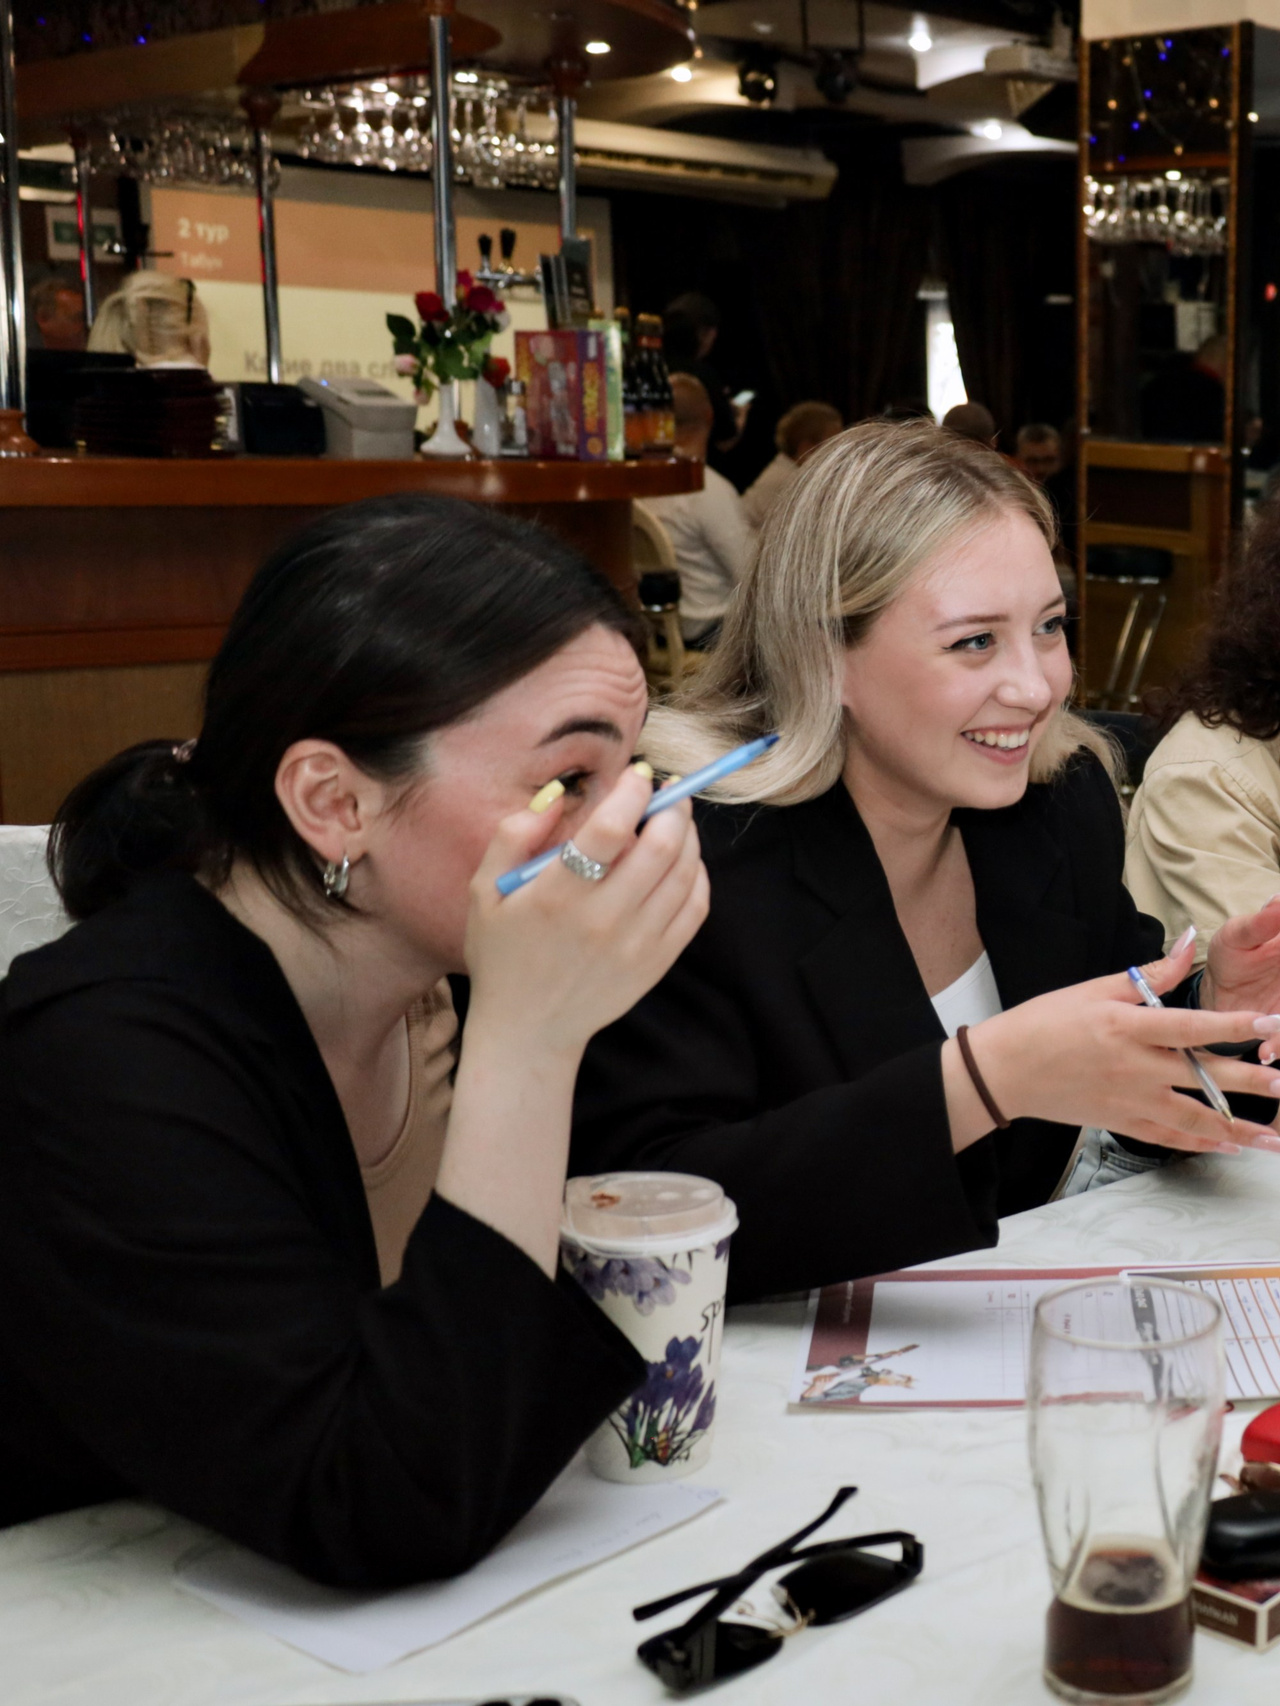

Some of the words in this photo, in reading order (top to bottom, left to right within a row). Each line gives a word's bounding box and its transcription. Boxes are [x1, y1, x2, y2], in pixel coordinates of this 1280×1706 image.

[178, 217, 191, 239] 2
[197, 222, 230, 245] тур
[245, 352, 312, 375] Кие
[319, 358, 361, 379] два
[700, 1294, 726, 1366] sp
